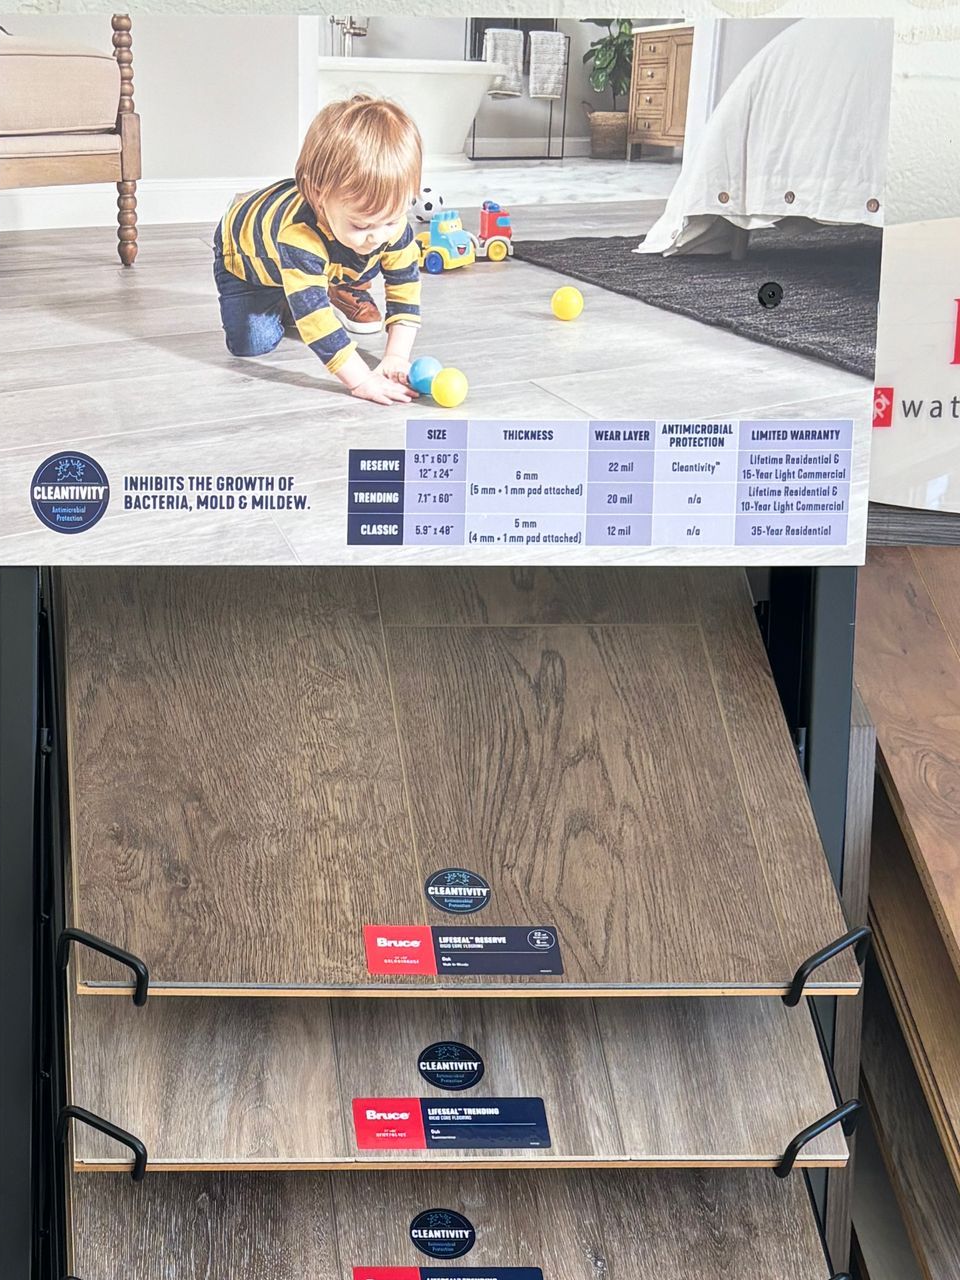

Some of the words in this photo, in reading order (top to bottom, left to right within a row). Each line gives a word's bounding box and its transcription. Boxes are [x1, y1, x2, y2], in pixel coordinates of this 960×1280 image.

[427, 430, 447, 440] SIZE
[662, 424, 733, 435] ANTIMICROBIAL
[751, 430, 788, 440] LIMITED
[790, 430, 840, 440] WARRANTY
[503, 430, 554, 441] THICKNESS
[595, 430, 621, 441] WEAR
[623, 430, 650, 441] LAYER
[669, 436, 725, 447] PROTECTION
[750, 454, 783, 465] Lifetime
[786, 454, 832, 464] Residential
[360, 460, 400, 471] RESERVE
[608, 463, 620, 472] 22
[621, 462, 634, 472] mil
[516, 471, 521, 480] 6
[775, 469, 795, 482] Light
[797, 469, 846, 480] Commercial
[124, 476, 184, 491] INHIBITS
[188, 476, 213, 491] THE
[216, 476, 276, 491] GROWTH
[278, 476, 294, 491] OF
[481, 487, 496, 495] mm
[510, 487, 525, 495] mm
[527, 485, 542, 497] pad
[748, 486, 782, 497] Lifetime
[784, 486, 830, 497] Residential
[353, 492, 399, 503] TRENDING
[607, 495, 618, 504] 20
[620, 494, 633, 504] mil
[688, 494, 701, 504] n/a
[124, 495, 193, 512] BACTERIA,
[196, 495, 234, 510] MOLD
[238, 495, 247, 510] &
[251, 495, 311, 510] MILDEW.
[741, 502, 771, 512] 10-Year
[773, 502, 794, 513] Light
[796, 501, 844, 512] Commercial
[514, 519, 520, 528] 5
[361, 525, 399, 535] CLASSIC
[607, 527, 617, 536] 12
[619, 526, 631, 536] mil
[687, 526, 700, 536] n/a
[751, 526, 783, 536] 35-Year
[785, 526, 831, 536] Residential
[480, 534, 495, 543] mm
[509, 534, 524, 543] mm
[526, 532, 540, 545] pad
[377, 938, 421, 948] Bruce
[366, 1110, 410, 1120] Bruce
